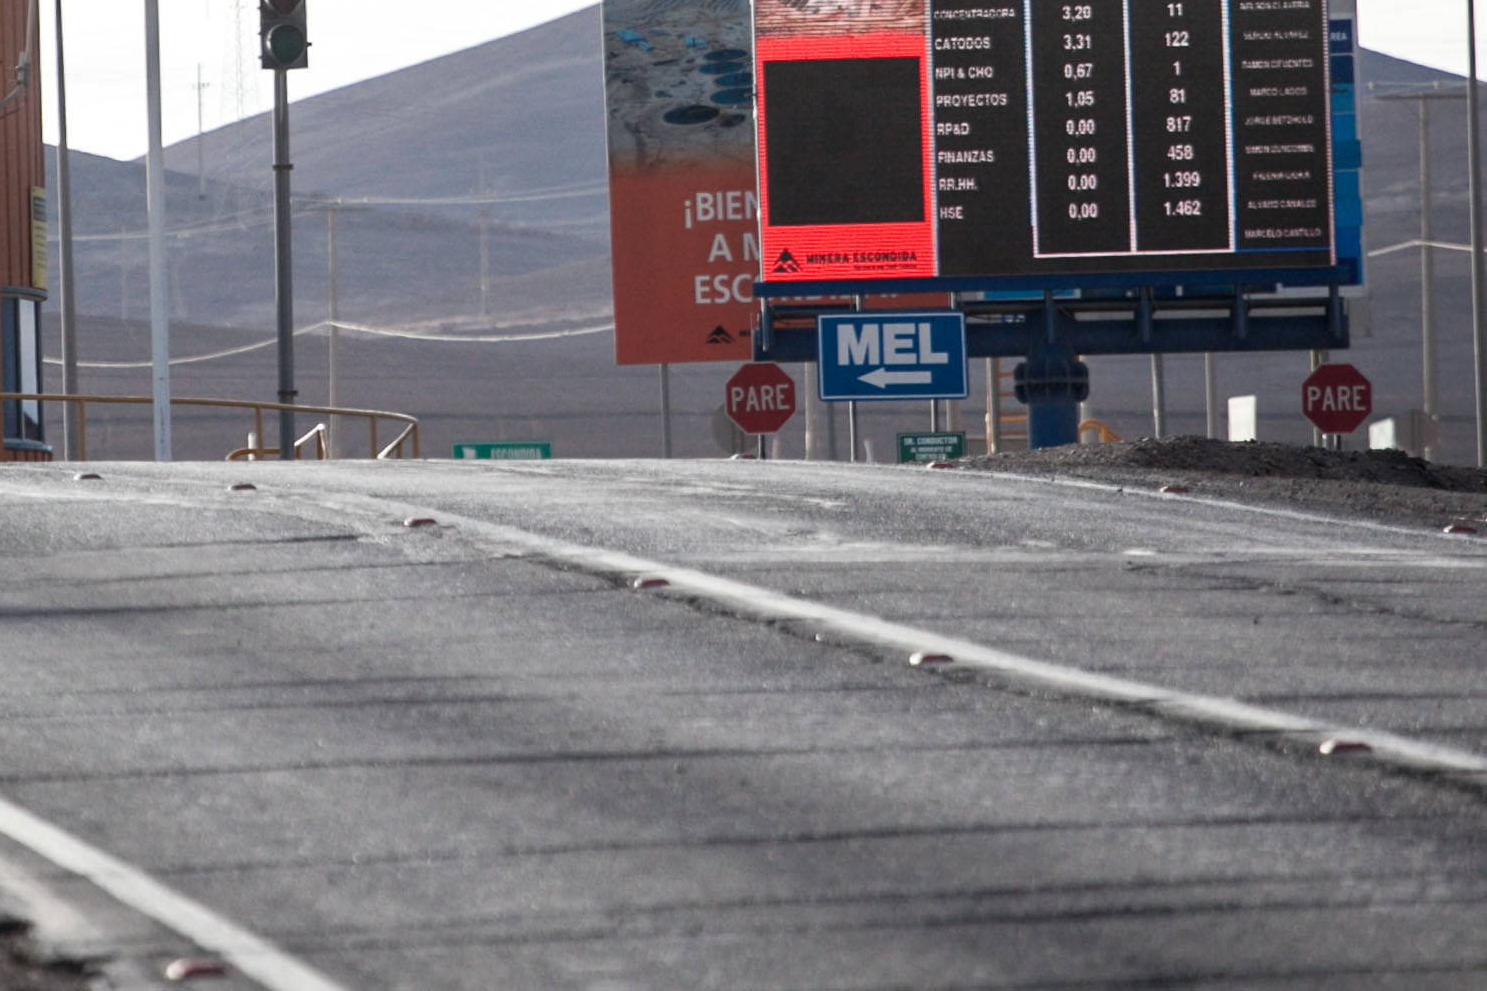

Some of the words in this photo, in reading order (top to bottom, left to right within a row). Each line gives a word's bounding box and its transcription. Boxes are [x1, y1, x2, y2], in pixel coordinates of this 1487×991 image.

[1166, 2, 1183, 17] 11
[934, 37, 991, 50] CATODOS
[1164, 31, 1189, 47] 122
[935, 67, 954, 79] NPI
[957, 67, 966, 79] &
[1172, 61, 1181, 76] 1
[936, 93, 1007, 107] PROYECTOS
[1169, 88, 1186, 104] 81
[1166, 115, 1192, 132] 817
[937, 150, 994, 163] FINANZAS
[1167, 144, 1194, 160] 458
[1163, 171, 1201, 188] 1.399
[939, 206, 963, 219] HSE
[1163, 200, 1201, 216] 1.462
[707, 232, 733, 263] A
[853, 251, 917, 263] ESCONDIDA
[837, 322, 949, 366] MEL
[730, 383, 791, 412] PARE
[1307, 384, 1368, 412] PARE
